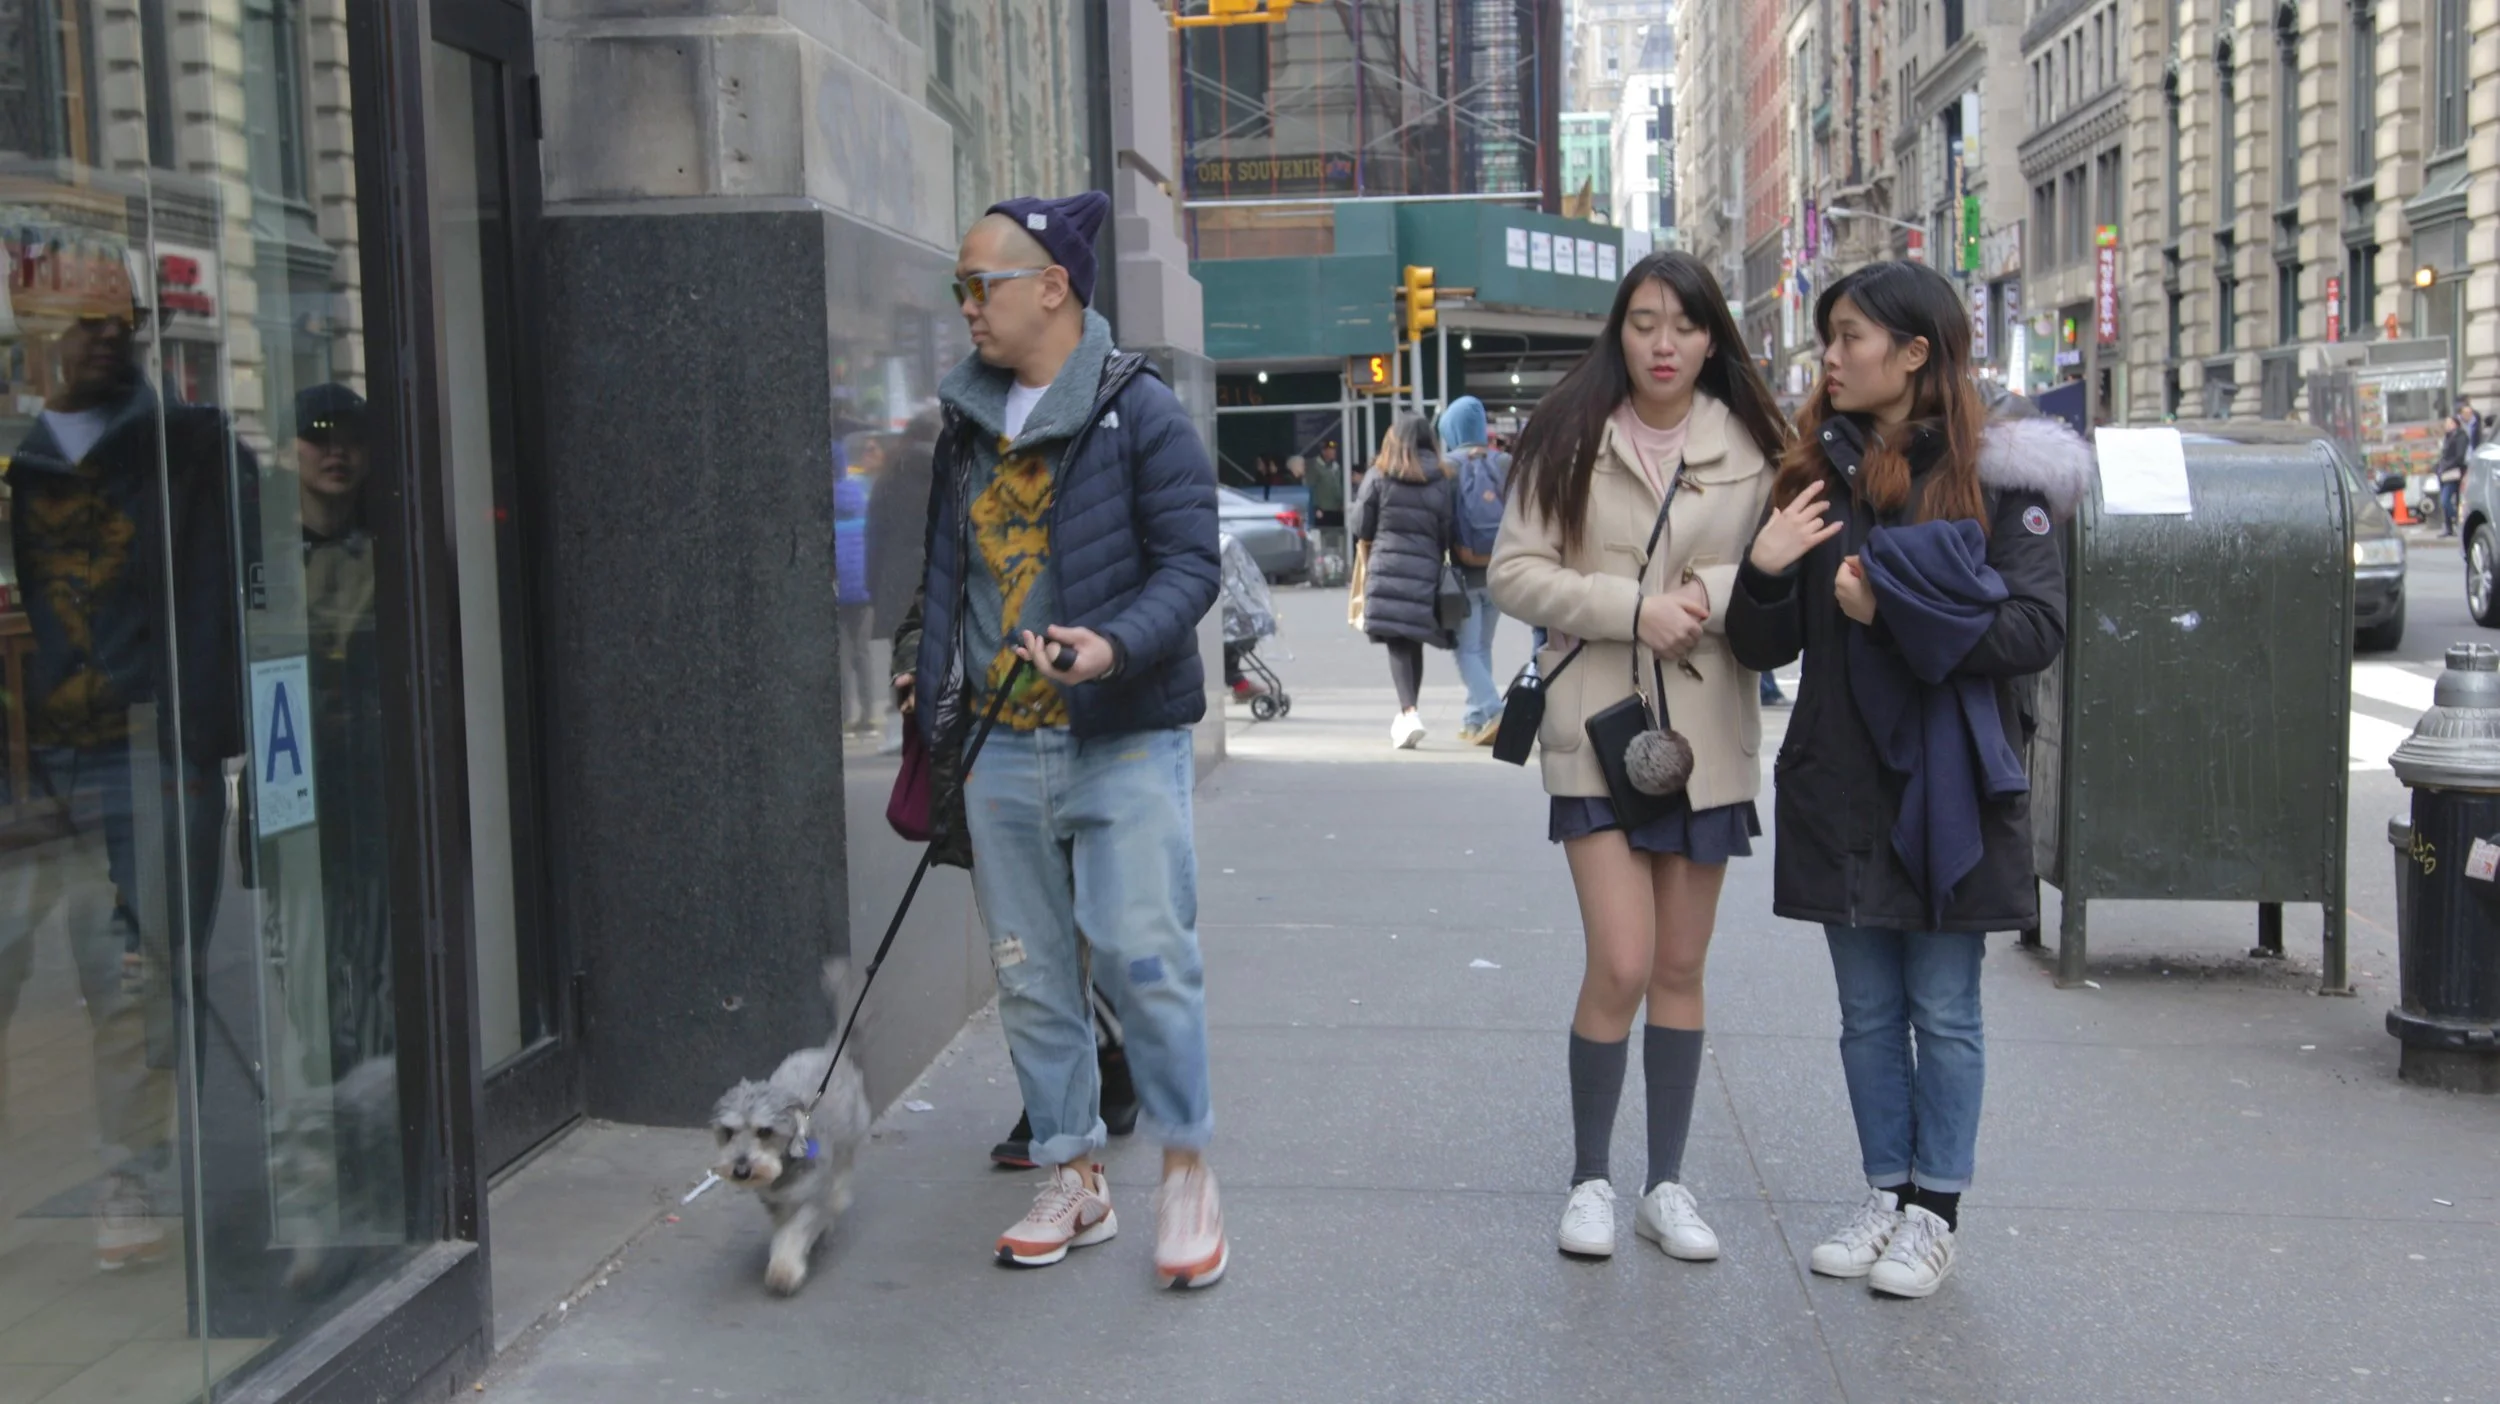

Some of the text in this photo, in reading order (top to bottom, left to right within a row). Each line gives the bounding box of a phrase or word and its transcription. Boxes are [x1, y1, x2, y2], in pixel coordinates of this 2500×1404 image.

[1237, 158, 1325, 181] SOUVENIR
[1371, 357, 1384, 383] 5
[266, 682, 303, 783] A
